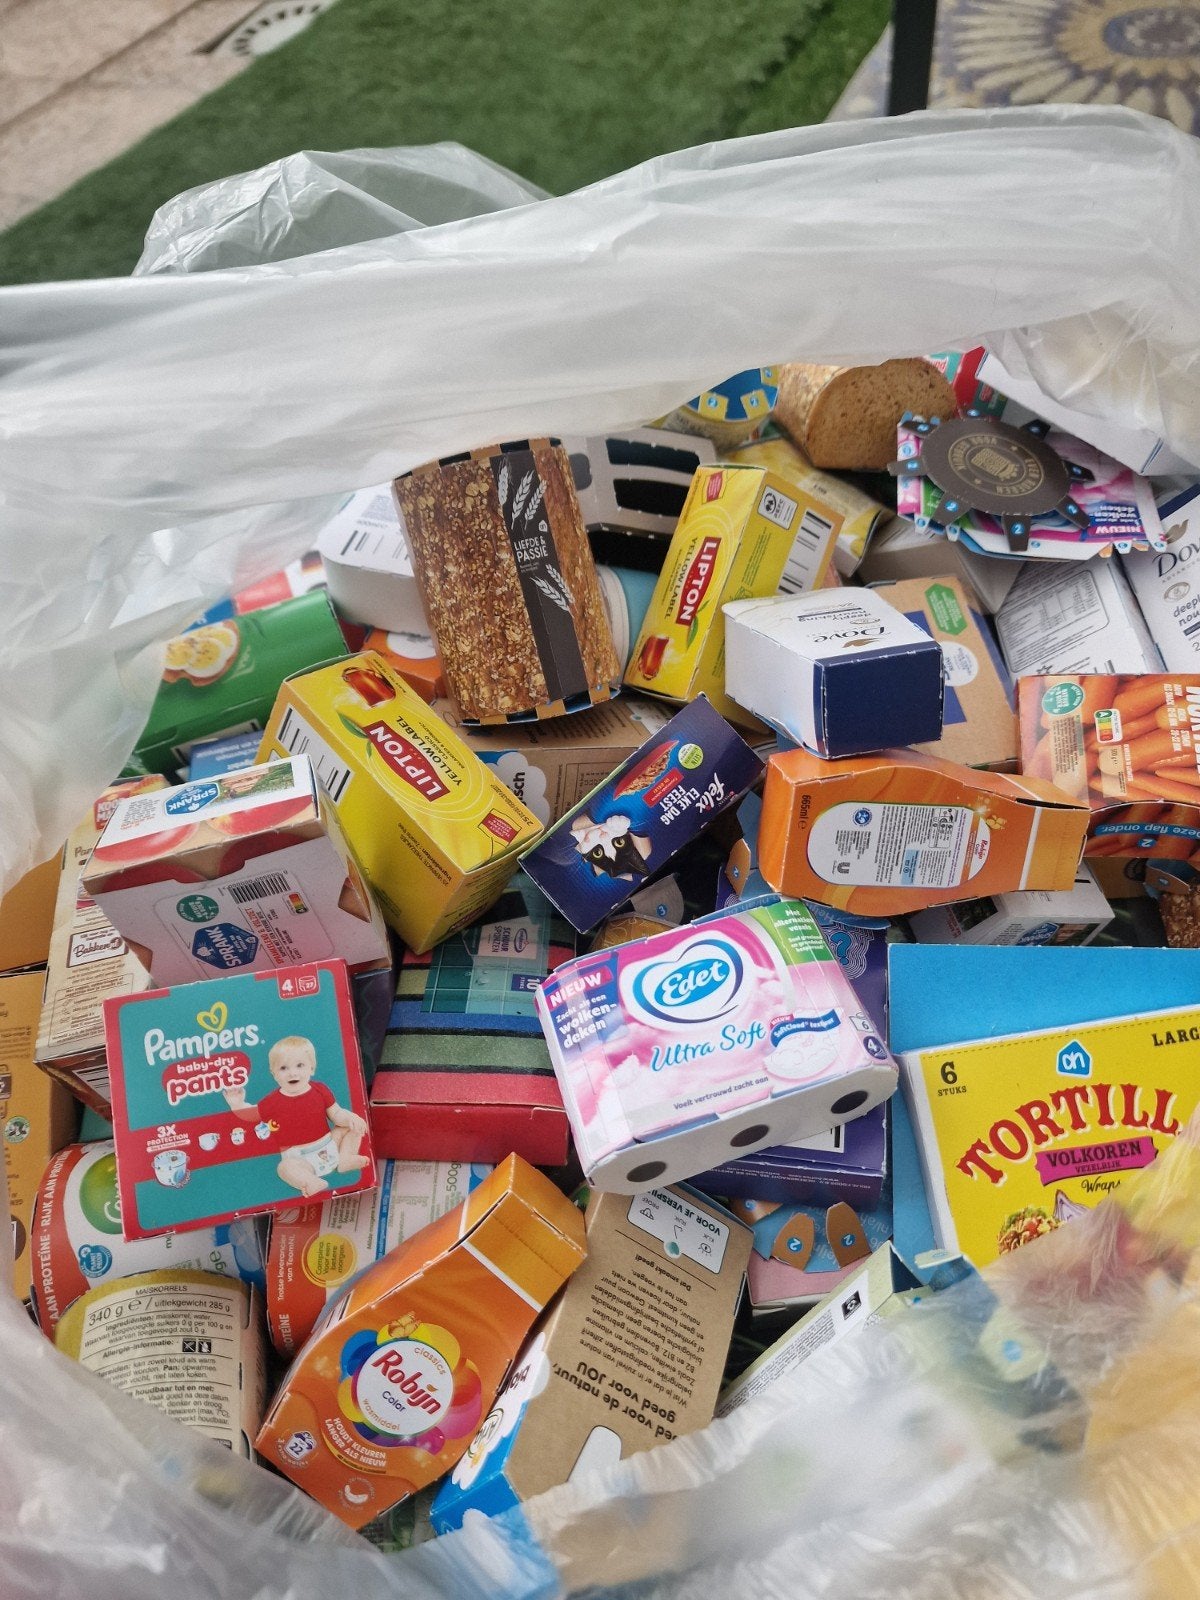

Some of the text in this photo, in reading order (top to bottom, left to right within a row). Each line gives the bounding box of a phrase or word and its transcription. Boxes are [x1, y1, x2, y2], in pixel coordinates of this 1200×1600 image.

[513, 535, 540, 551] LIEFDE
[1014, 524, 1023, 534] 2
[515, 544, 548, 563] PASSIE
[676, 535, 698, 583] YELLOW
[678, 538, 718, 622] LIPTON
[663, 584, 682, 620] LABEL
[812, 625, 891, 644] Dove
[369, 724, 443, 797] LIPTON
[393, 714, 463, 786] YELLOW LABEL
[166, 786, 217, 812] SPRANK
[656, 783, 687, 812] FEEST
[674, 786, 701, 811] ELKE
[799, 794, 811, 818] 665ml
[657, 804, 681, 826] DAG
[1143, 822, 1169, 834] flap
[1140, 837, 1153, 848] 2
[205, 923, 242, 970] SPRANK
[491, 925, 502, 953] SPONZEN
[500, 926, 511, 952] SCHUUR
[281, 978, 292, 992] 4
[548, 970, 604, 1008] NIEUW
[658, 962, 726, 999] Edet
[554, 992, 607, 1023] Zacht als een
[558, 998, 618, 1036] wolken-
[143, 1023, 260, 1066] Pampers
[560, 1017, 607, 1049] deken
[650, 1020, 768, 1072] Ultra Soft
[867, 1041, 877, 1053] 4
[176, 1056, 235, 1075] baby-dry
[940, 1061, 957, 1085] 6
[168, 1066, 248, 1105] pants
[672, 1075, 769, 1110] Voelt vertrouwd zacht aan
[937, 1085, 967, 1097] STUKS
[147, 1132, 189, 1147] PROTECTION
[157, 1124, 176, 1137] 3X
[1046, 1140, 1142, 1167] VOLKOREN
[1075, 1160, 1122, 1174] VEZELRIJK
[683, 1207, 721, 1235] VOOR JE
[38, 1176, 59, 1321] AAN PROTEÏNE RIJK AAN
[277, 1232, 287, 1278] leverancier
[314, 1240, 325, 1275] Campina
[329, 1244, 338, 1270] betere
[629, 1268, 655, 1286] voegen.
[653, 1265, 679, 1283] smaakt
[134, 1284, 188, 1296] MAISKORRELS
[600, 1274, 695, 1334] geen Gewoon puur
[609, 1269, 678, 1313] daar hoeven niets
[87, 1299, 224, 1327] 340 g uitlekgewicht 285
[592, 1283, 697, 1348] synthetische bestrijdingsmiddelen
[590, 1294, 703, 1364] biologische boeren geen chemische
[591, 1307, 660, 1351] Bovendien gebruiken
[101, 1338, 174, 1359] Allergie-informatie:
[167, 1355, 186, 1364] koud
[413, 1345, 446, 1376] classics
[584, 1316, 696, 1385] Zoals calcium vitamine
[162, 1363, 180, 1372] Pan:
[548, 1361, 601, 1398] natuur,
[578, 1338, 688, 1407] Wist zuivel nature
[603, 1339, 692, 1396] belangrijke voedingsstoffen
[371, 1349, 441, 1416] Robijn
[574, 1359, 677, 1423] goed voor JOU
[362, 1397, 401, 1431] wasmiddel
[381, 1389, 406, 1413] Color
[599, 1393, 620, 1411] de
[621, 1405, 655, 1430] voor
[287, 1440, 305, 1457] 22
[323, 1416, 346, 1450] LANGER
[342, 1445, 360, 1460] ALS
[358, 1453, 387, 1468] NIEUW
[331, 1415, 388, 1459] HOUDT KLEUREN
